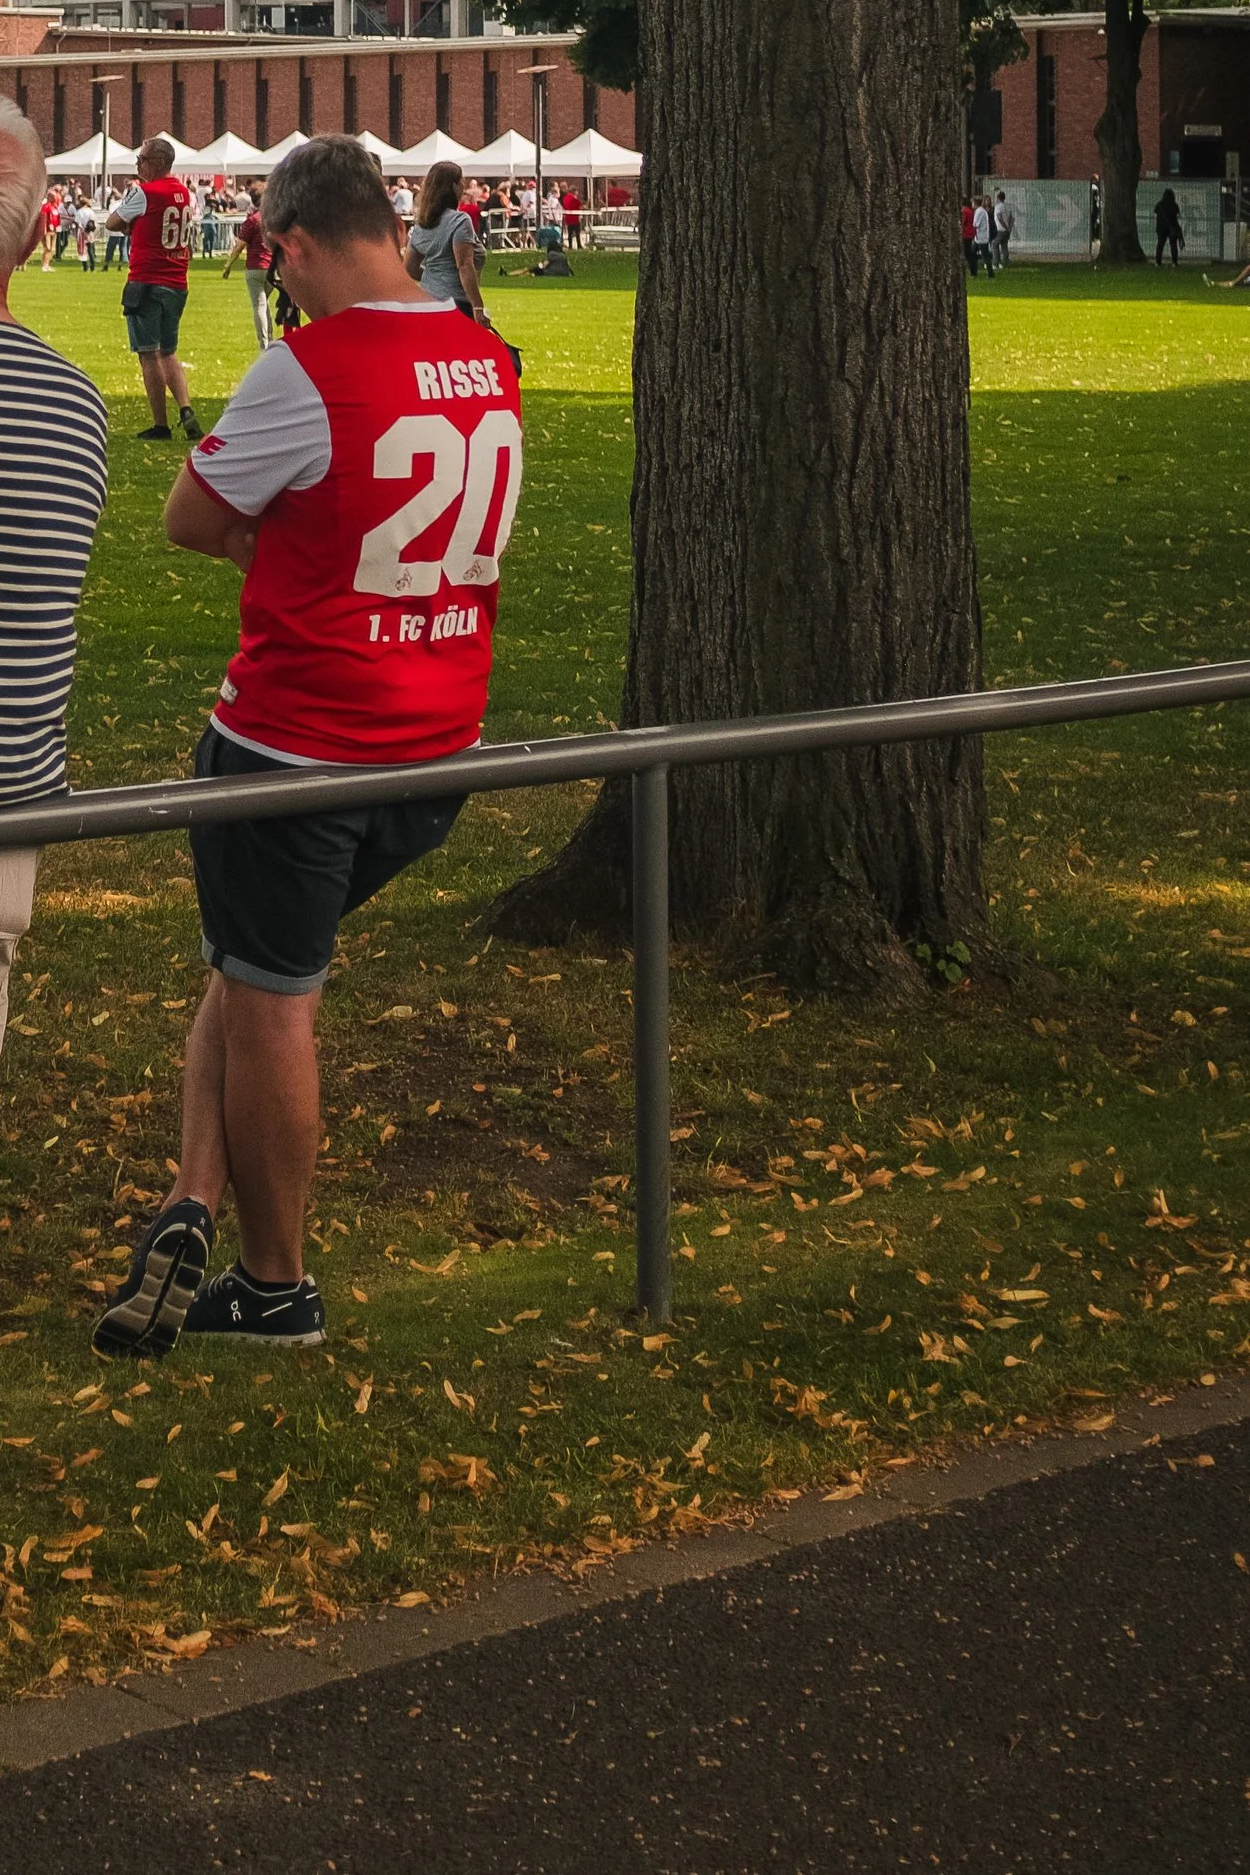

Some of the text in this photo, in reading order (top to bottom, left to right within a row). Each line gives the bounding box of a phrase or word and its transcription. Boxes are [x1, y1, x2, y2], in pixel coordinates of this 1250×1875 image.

[414, 359, 504, 401] RISSE
[353, 410, 523, 597] 20
[369, 605, 478, 642] 1. FC KÖLN
